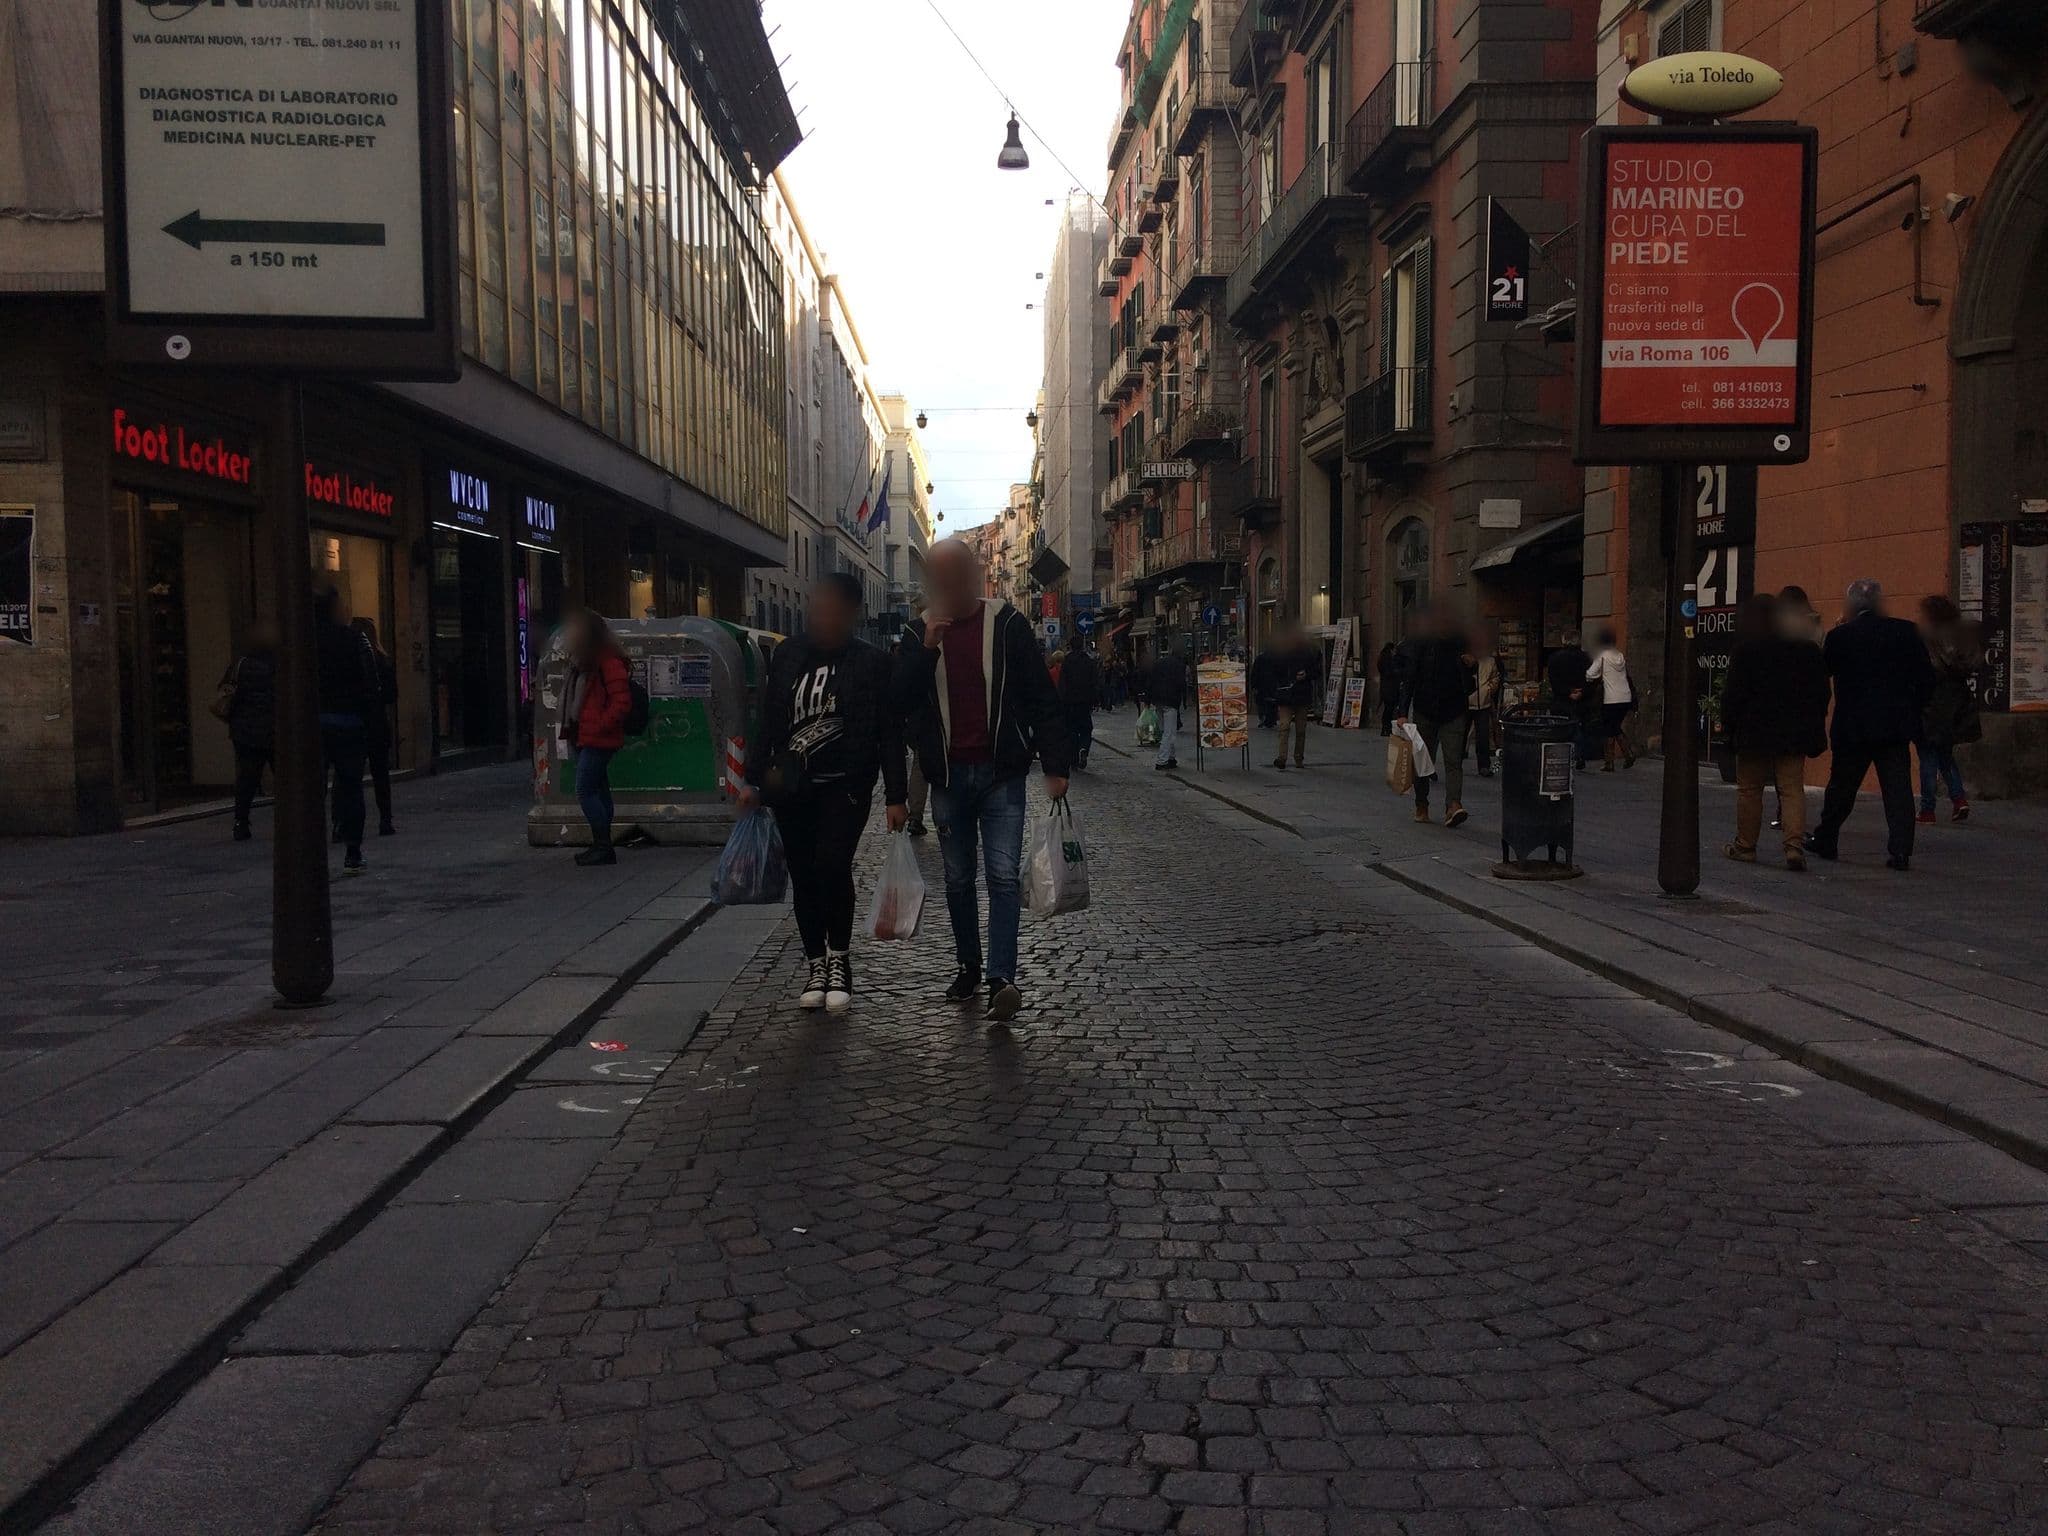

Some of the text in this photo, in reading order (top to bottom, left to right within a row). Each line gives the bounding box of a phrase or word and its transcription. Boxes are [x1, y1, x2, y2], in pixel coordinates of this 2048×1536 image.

[374, 0, 400, 11] SRL
[132, 34, 151, 44] VIA
[154, 35, 205, 45] GUANTAI
[208, 36, 247, 46] NUOVI,
[251, 37, 282, 47] 13/17
[294, 37, 319, 47] TEL.
[322, 38, 367, 49] 081.240
[1668, 67, 1754, 84] via Toledo
[139, 87, 398, 106] DIAGNOSTICA DI LABORATORIO
[153, 109, 386, 127] DIAGNOSTICA RADIOLOGICA
[164, 130, 376, 148] MEDICINA NUCLEARE-PET
[1612, 159, 1713, 182] STUDIO
[1612, 186, 1744, 210] MARINEO
[1611, 214, 1747, 237] CURA DEL
[230, 251, 318, 268] a 150 mt
[1610, 241, 1689, 265] PIEDE
[1492, 277, 1524, 302] 21
[1608, 283, 1669, 296] Ci siamo
[1608, 301, 1704, 314] trasferiti nella
[1608, 318, 1704, 331] nuova sede di
[1608, 346, 1730, 361] via Roma 106
[1682, 382, 1782, 393] tel. 081 416013
[1681, 398, 1790, 410] cell. 366 3332473
[112, 407, 251, 485] Foot Locker
[1142, 463, 1189, 477] PELLICCE
[304, 462, 395, 517] Foot Locker
[449, 469, 489, 512] WYCON
[1696, 465, 1727, 518] 21
[526, 496, 556, 532] WYCON
[1697, 518, 1726, 537] HORE
[1696, 546, 1739, 608] 21
[1697, 612, 1736, 634] HORE
